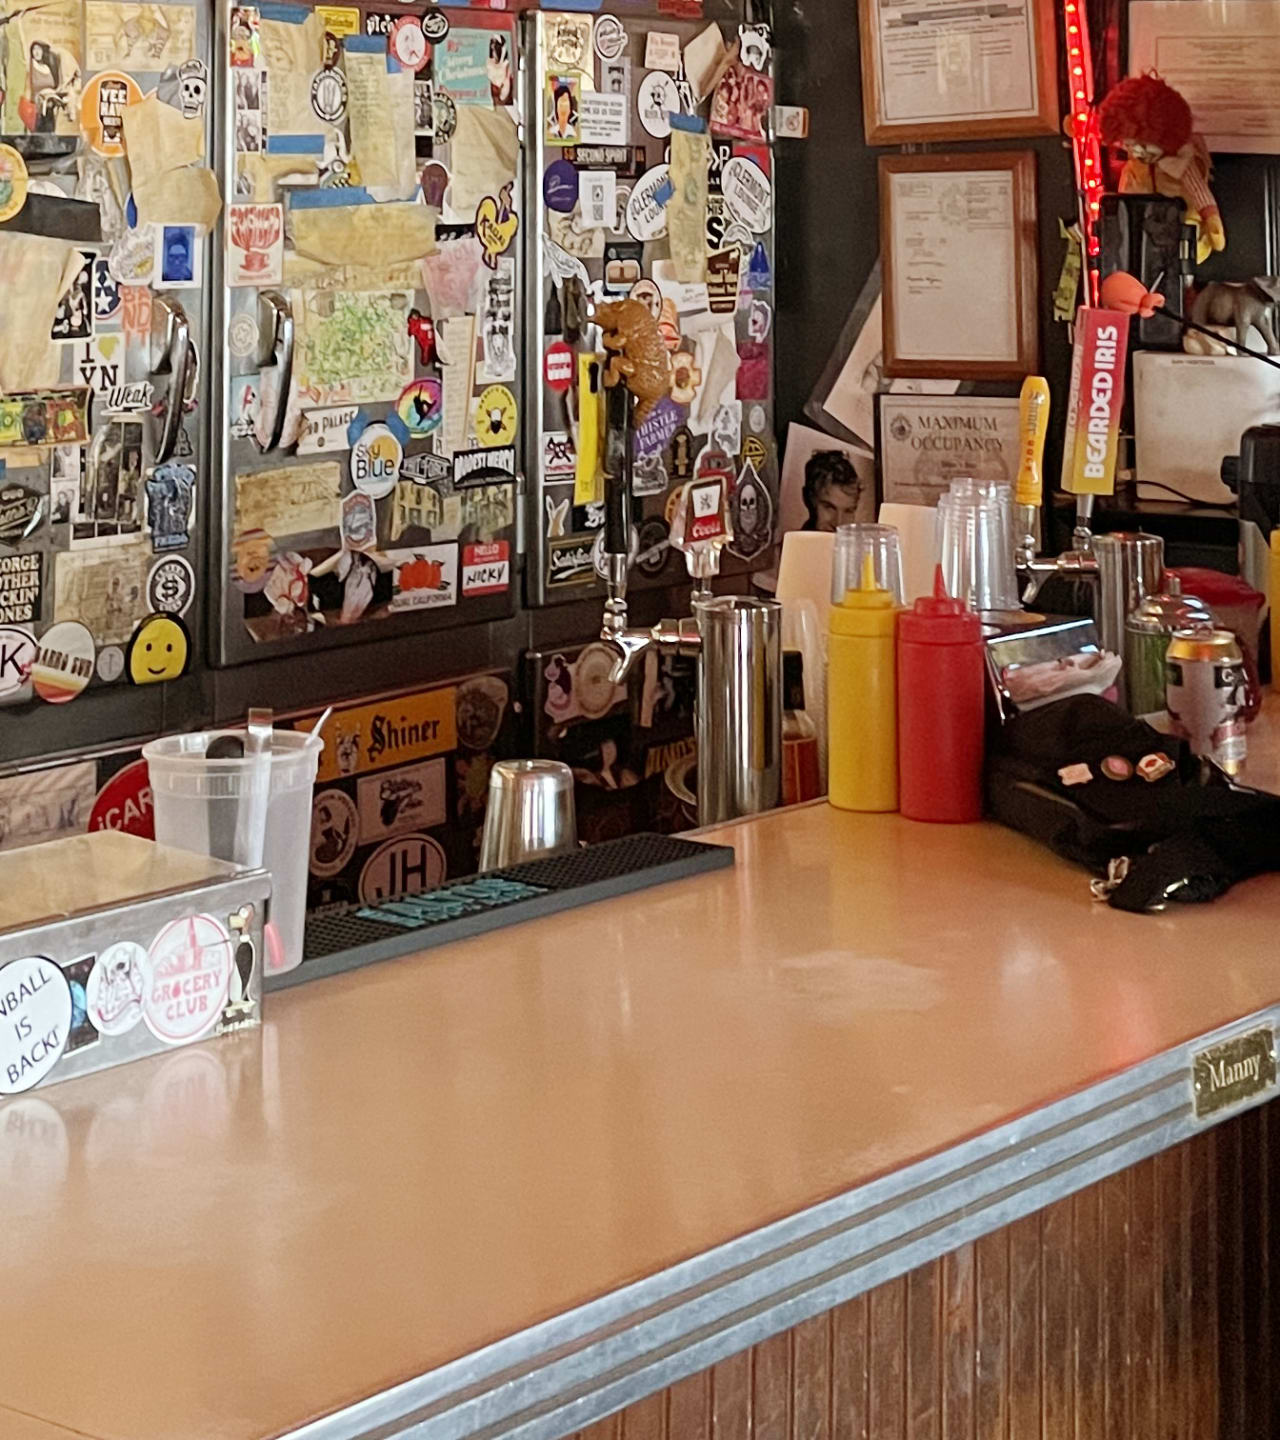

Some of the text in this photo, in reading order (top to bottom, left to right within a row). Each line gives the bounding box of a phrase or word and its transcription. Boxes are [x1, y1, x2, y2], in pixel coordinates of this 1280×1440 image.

[101, 89, 126, 103] YEE
[81, 342, 95, 364] I
[1094, 325, 1118, 369] IRIS
[108, 383, 151, 408] Weak
[918, 415, 998, 431] MAXIMUM
[1083, 371, 1113, 478] BEARDED
[355, 441, 381, 459] Sky
[911, 436, 1003, 452] OCCUPANCY
[356, 459, 395, 479] Blue
[466, 563, 506, 586] NICKY
[367, 714, 440, 763] Shiner
[375, 843, 427, 899] JH
[166, 994, 208, 1021] CLUB
[14, 1016, 33, 1041] IS
[1200, 1053, 1261, 1092] Manny
